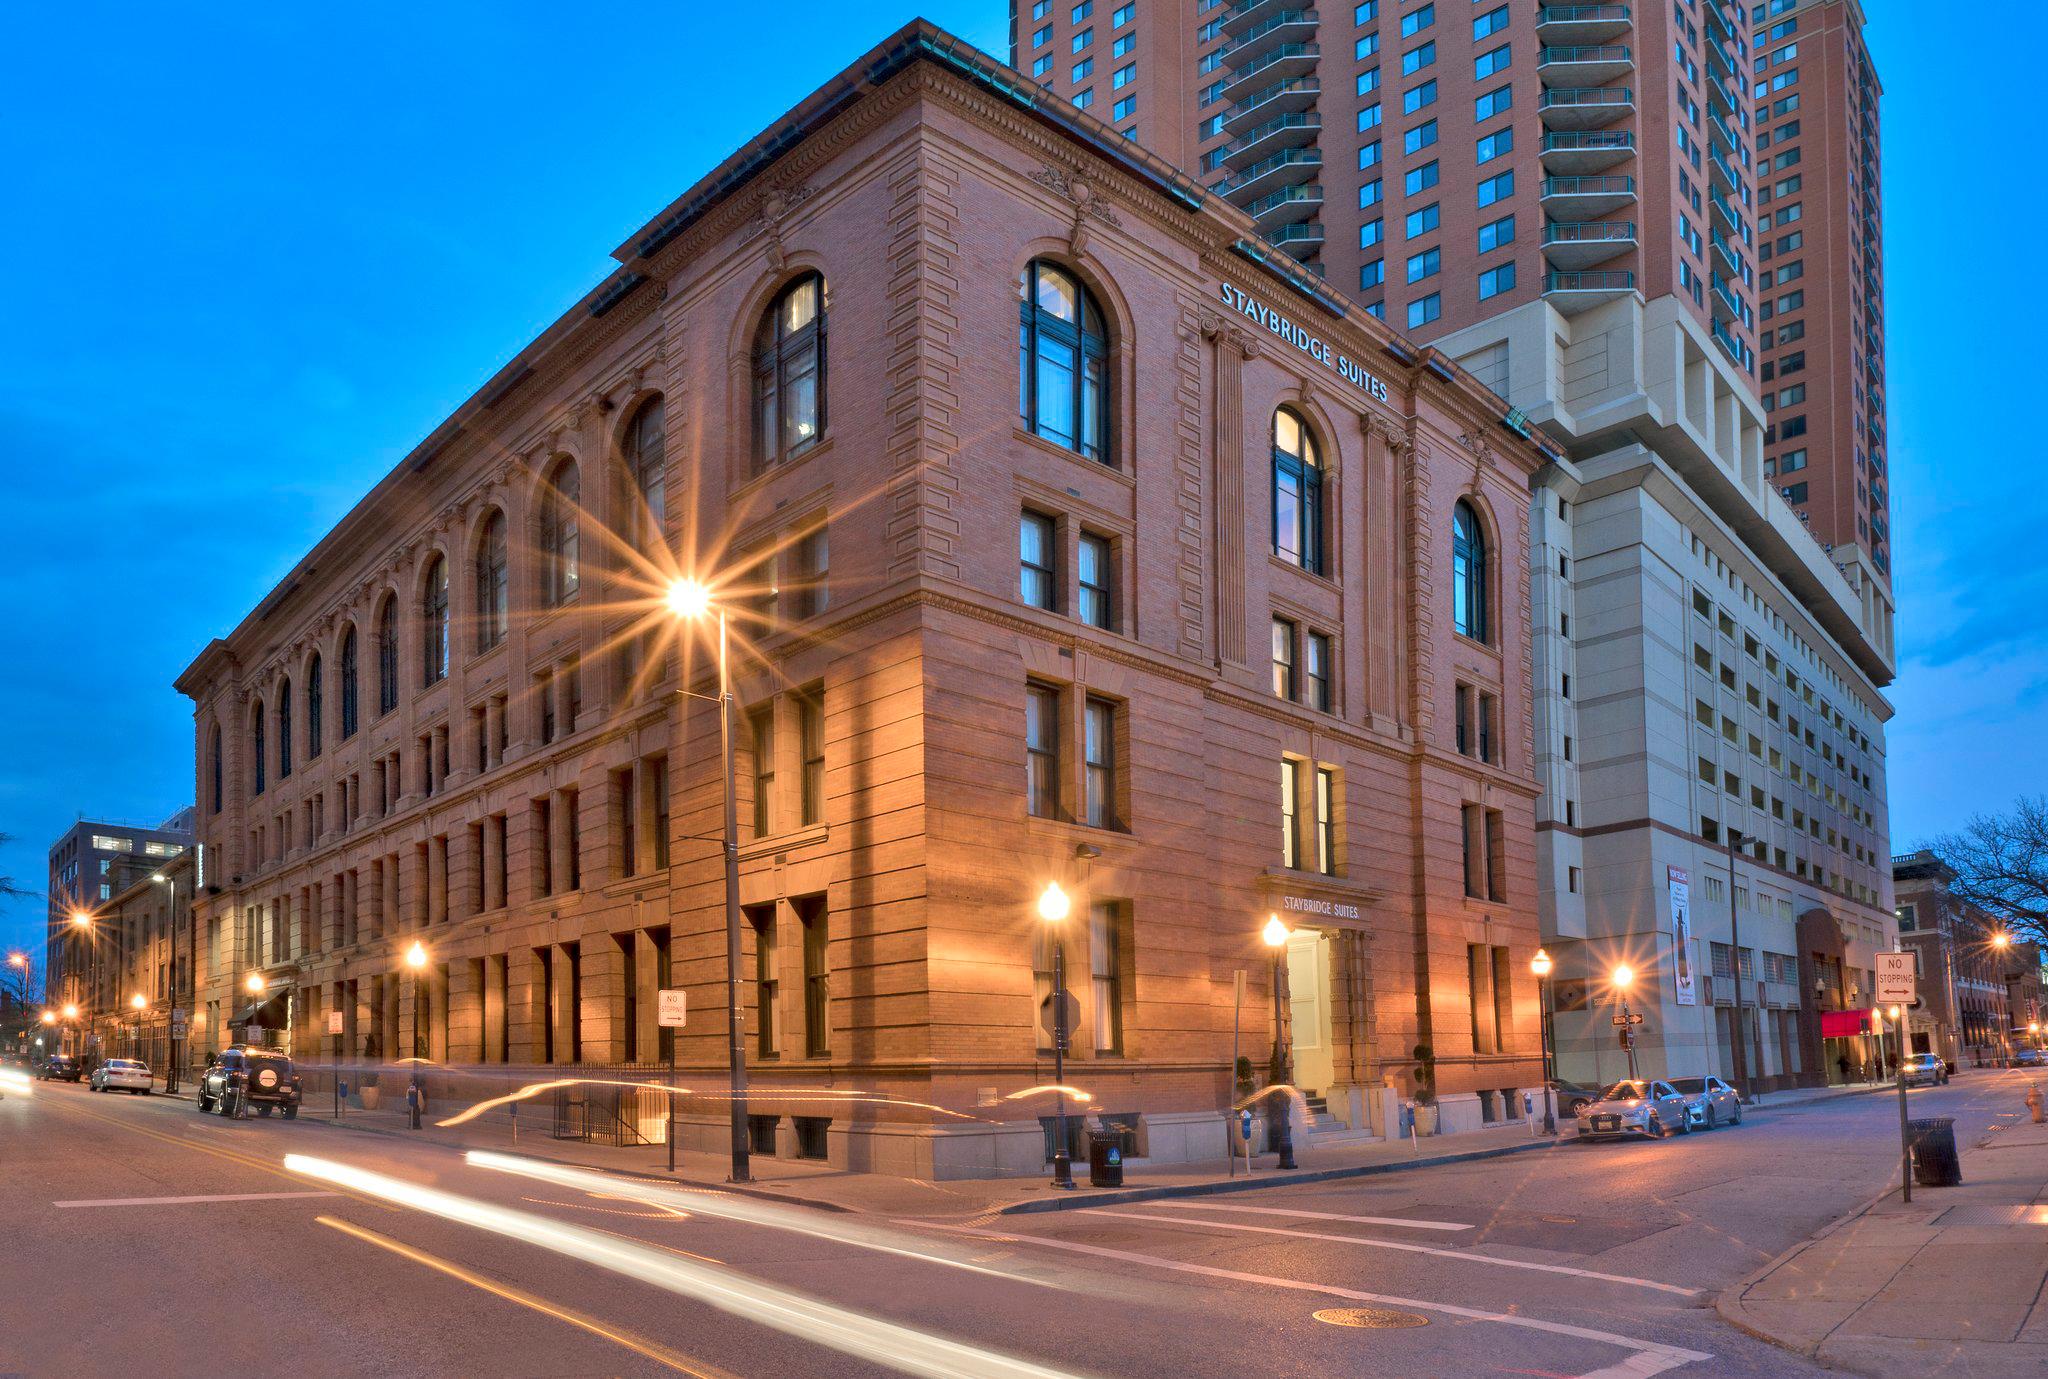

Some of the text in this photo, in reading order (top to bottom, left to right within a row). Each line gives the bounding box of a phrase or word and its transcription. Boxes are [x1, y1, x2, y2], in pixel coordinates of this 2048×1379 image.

[1222, 282, 1388, 402] STAYBRIDGE SUITES
[1284, 896, 1331, 914] STAYBRIDGE
[1888, 959, 1902, 968] NO
[1880, 974, 1912, 983] STOPPING
